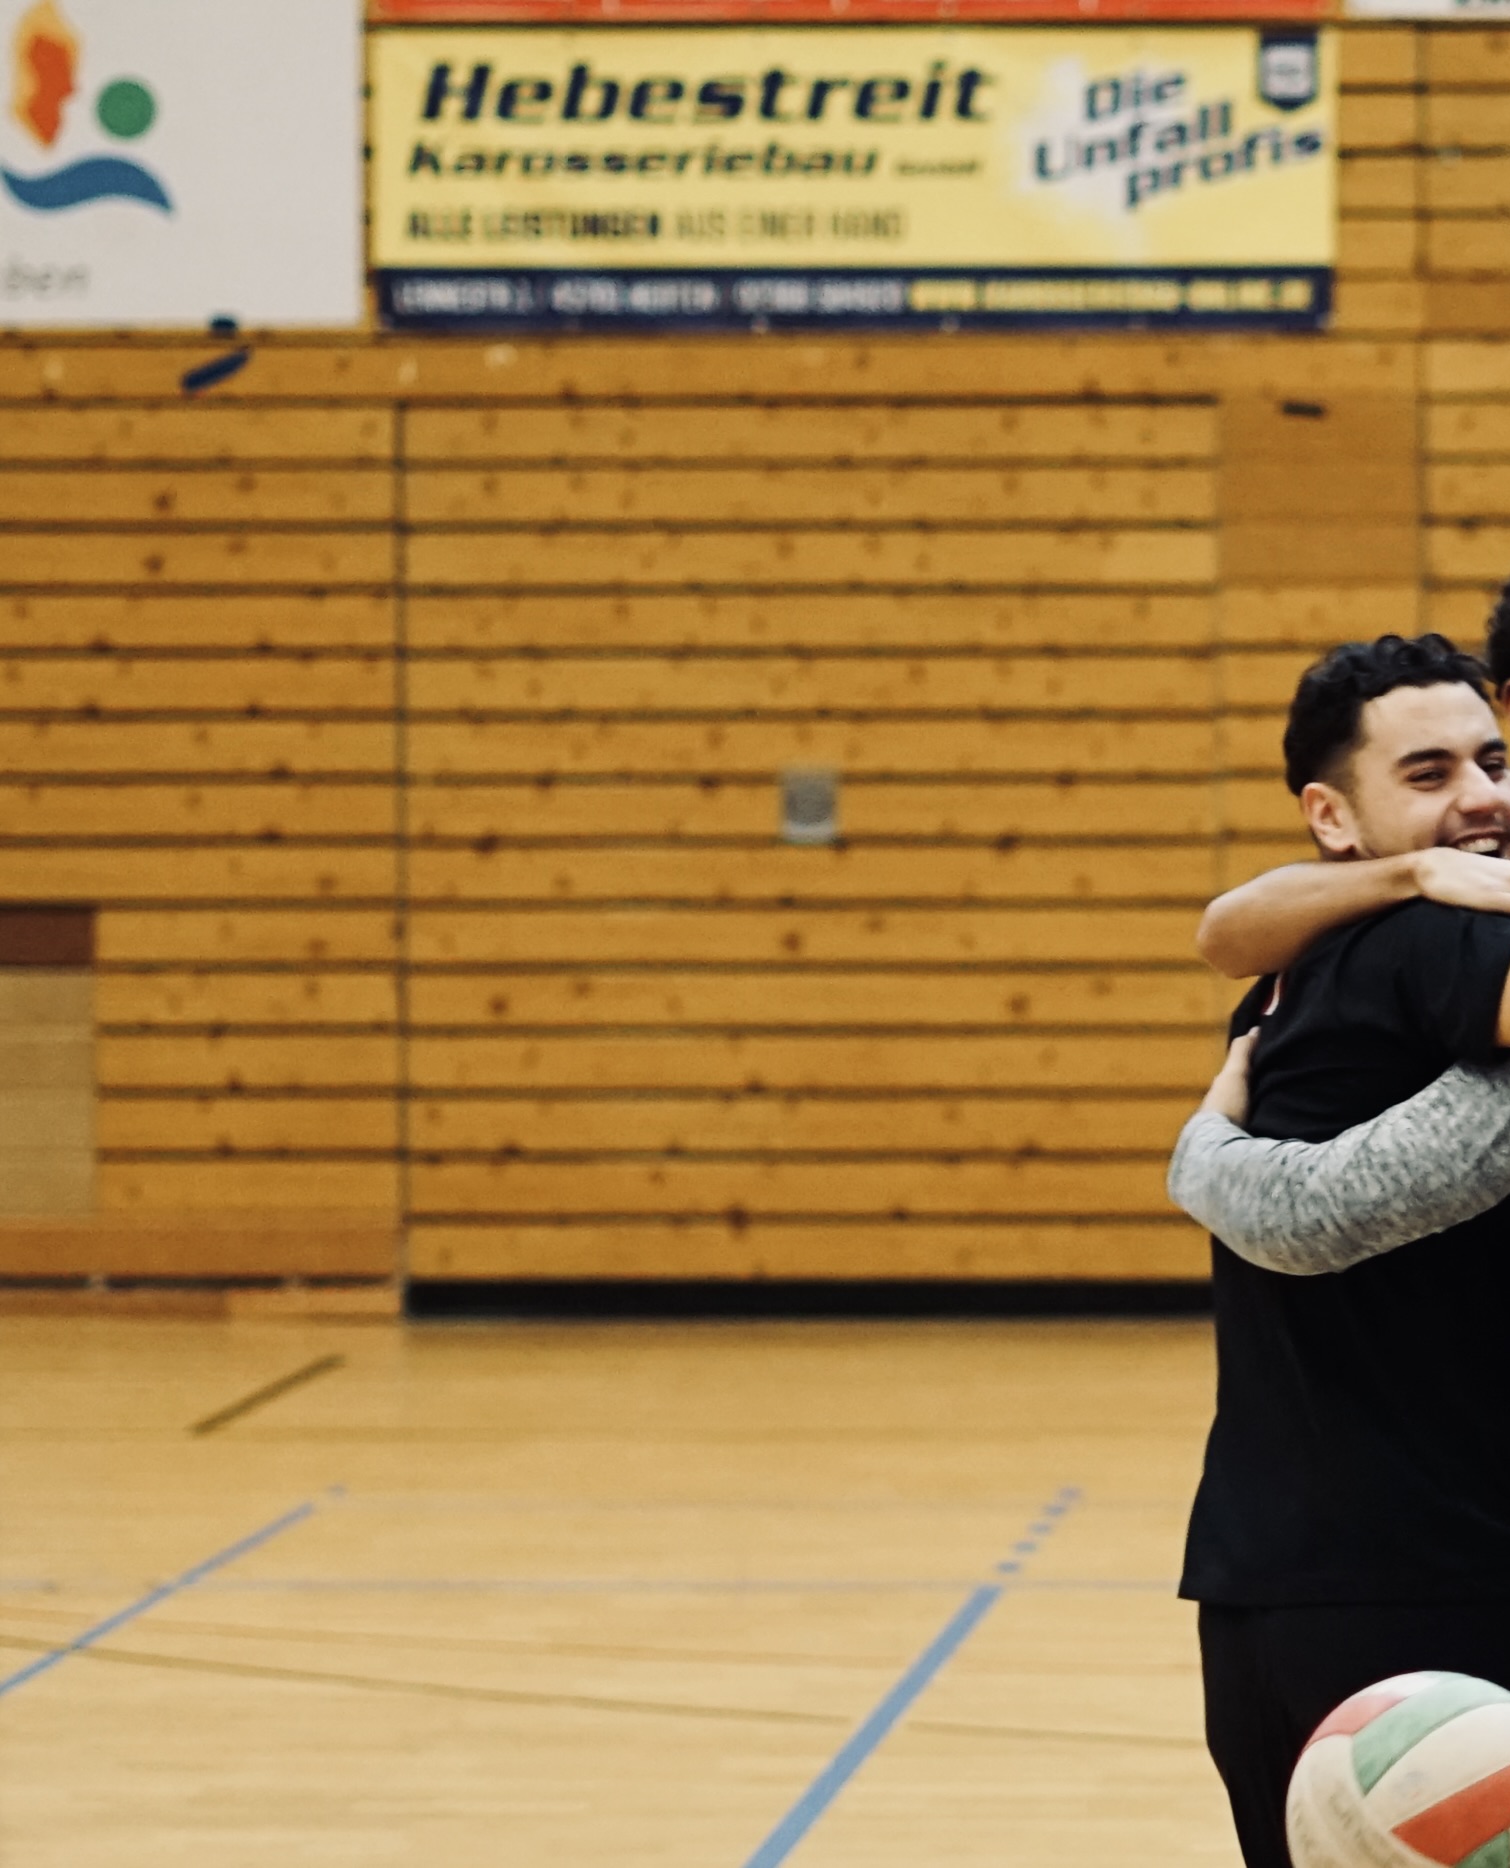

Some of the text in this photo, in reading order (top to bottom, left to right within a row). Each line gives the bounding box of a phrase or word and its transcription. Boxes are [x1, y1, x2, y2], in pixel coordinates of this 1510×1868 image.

[419, 58, 994, 123] Hebestreit
[1084, 72, 1186, 122] Die
[407, 140, 880, 178] Karosseriebau
[1034, 101, 1232, 181] Unfall
[1125, 126, 1323, 210] profis
